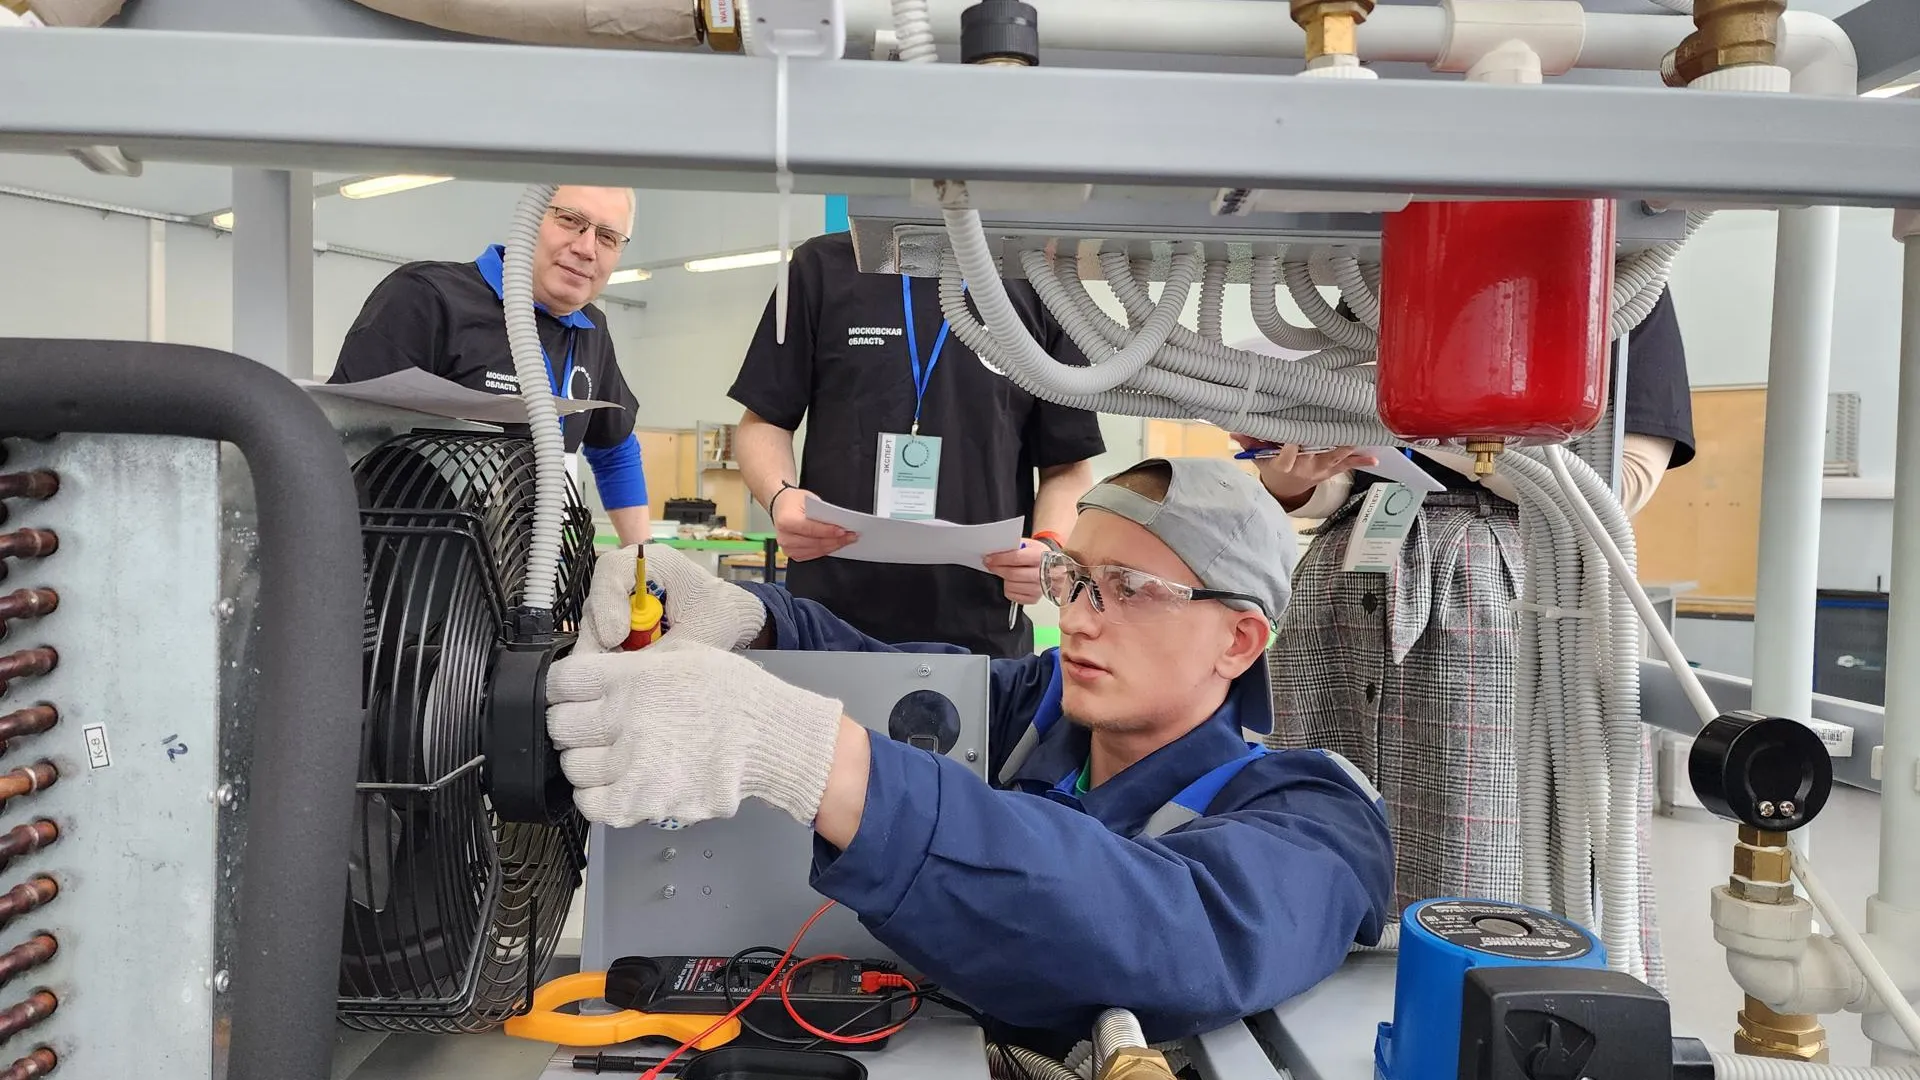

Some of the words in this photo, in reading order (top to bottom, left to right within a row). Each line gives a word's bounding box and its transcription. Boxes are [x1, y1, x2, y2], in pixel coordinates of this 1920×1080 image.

[848, 327, 902, 336] МОСКОВСКАЯ
[848, 337, 885, 345] ОБЛАСТЬ
[486, 371, 518, 383] МОСКОВС
[485, 380, 517, 391] ОБЛАСТЬ
[883, 439, 892, 474] ЭКСПЕРТ
[1362, 488, 1382, 524] ЭКСПЕРТ
